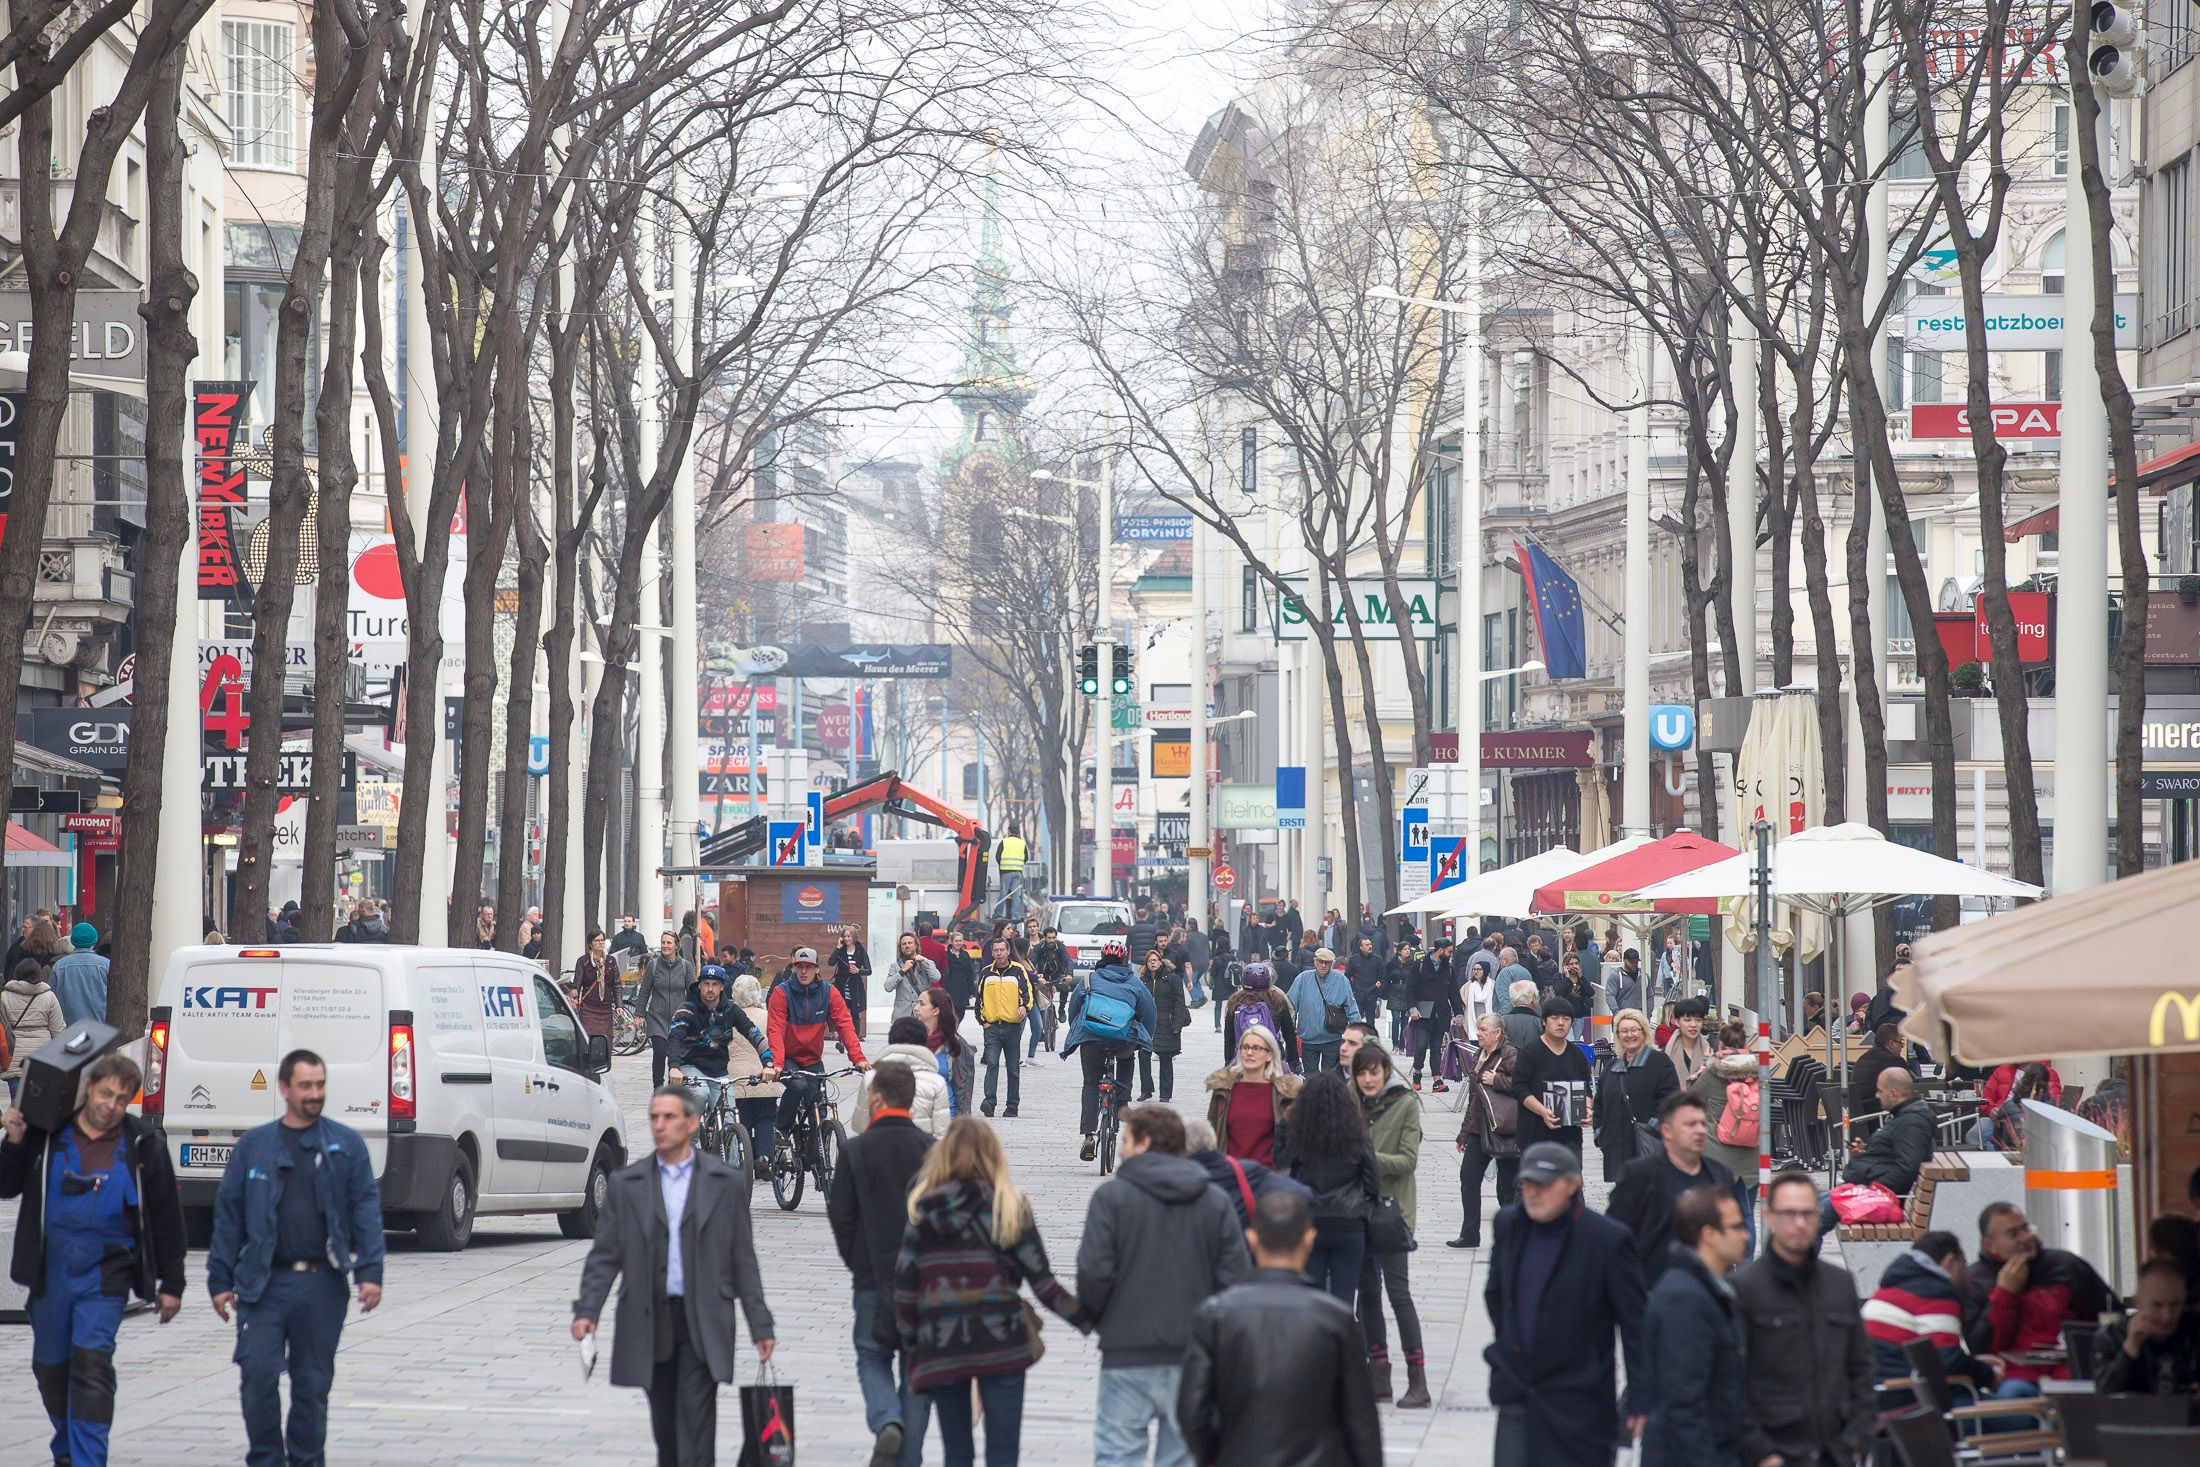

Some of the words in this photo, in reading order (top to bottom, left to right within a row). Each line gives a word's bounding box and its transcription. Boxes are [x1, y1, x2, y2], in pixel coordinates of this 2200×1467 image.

[1957, 409, 2062, 433] SPA
[1282, 594, 1435, 624] SAMA
[864, 664, 888, 673] Haus
[889, 664, 905, 674] des
[905, 664, 939, 674] Meeres
[1657, 714, 1686, 745] U
[69, 746, 107, 754] GRAIN
[110, 746, 127, 754] DE
[1435, 747, 1491, 760] HOL
[1494, 747, 1567, 760] KUMMER
[68, 817, 112, 827] AUTOMAT
[1159, 821, 1189, 839] KIN
[183, 986, 278, 1009] KAT
[481, 986, 524, 1017] KAT
